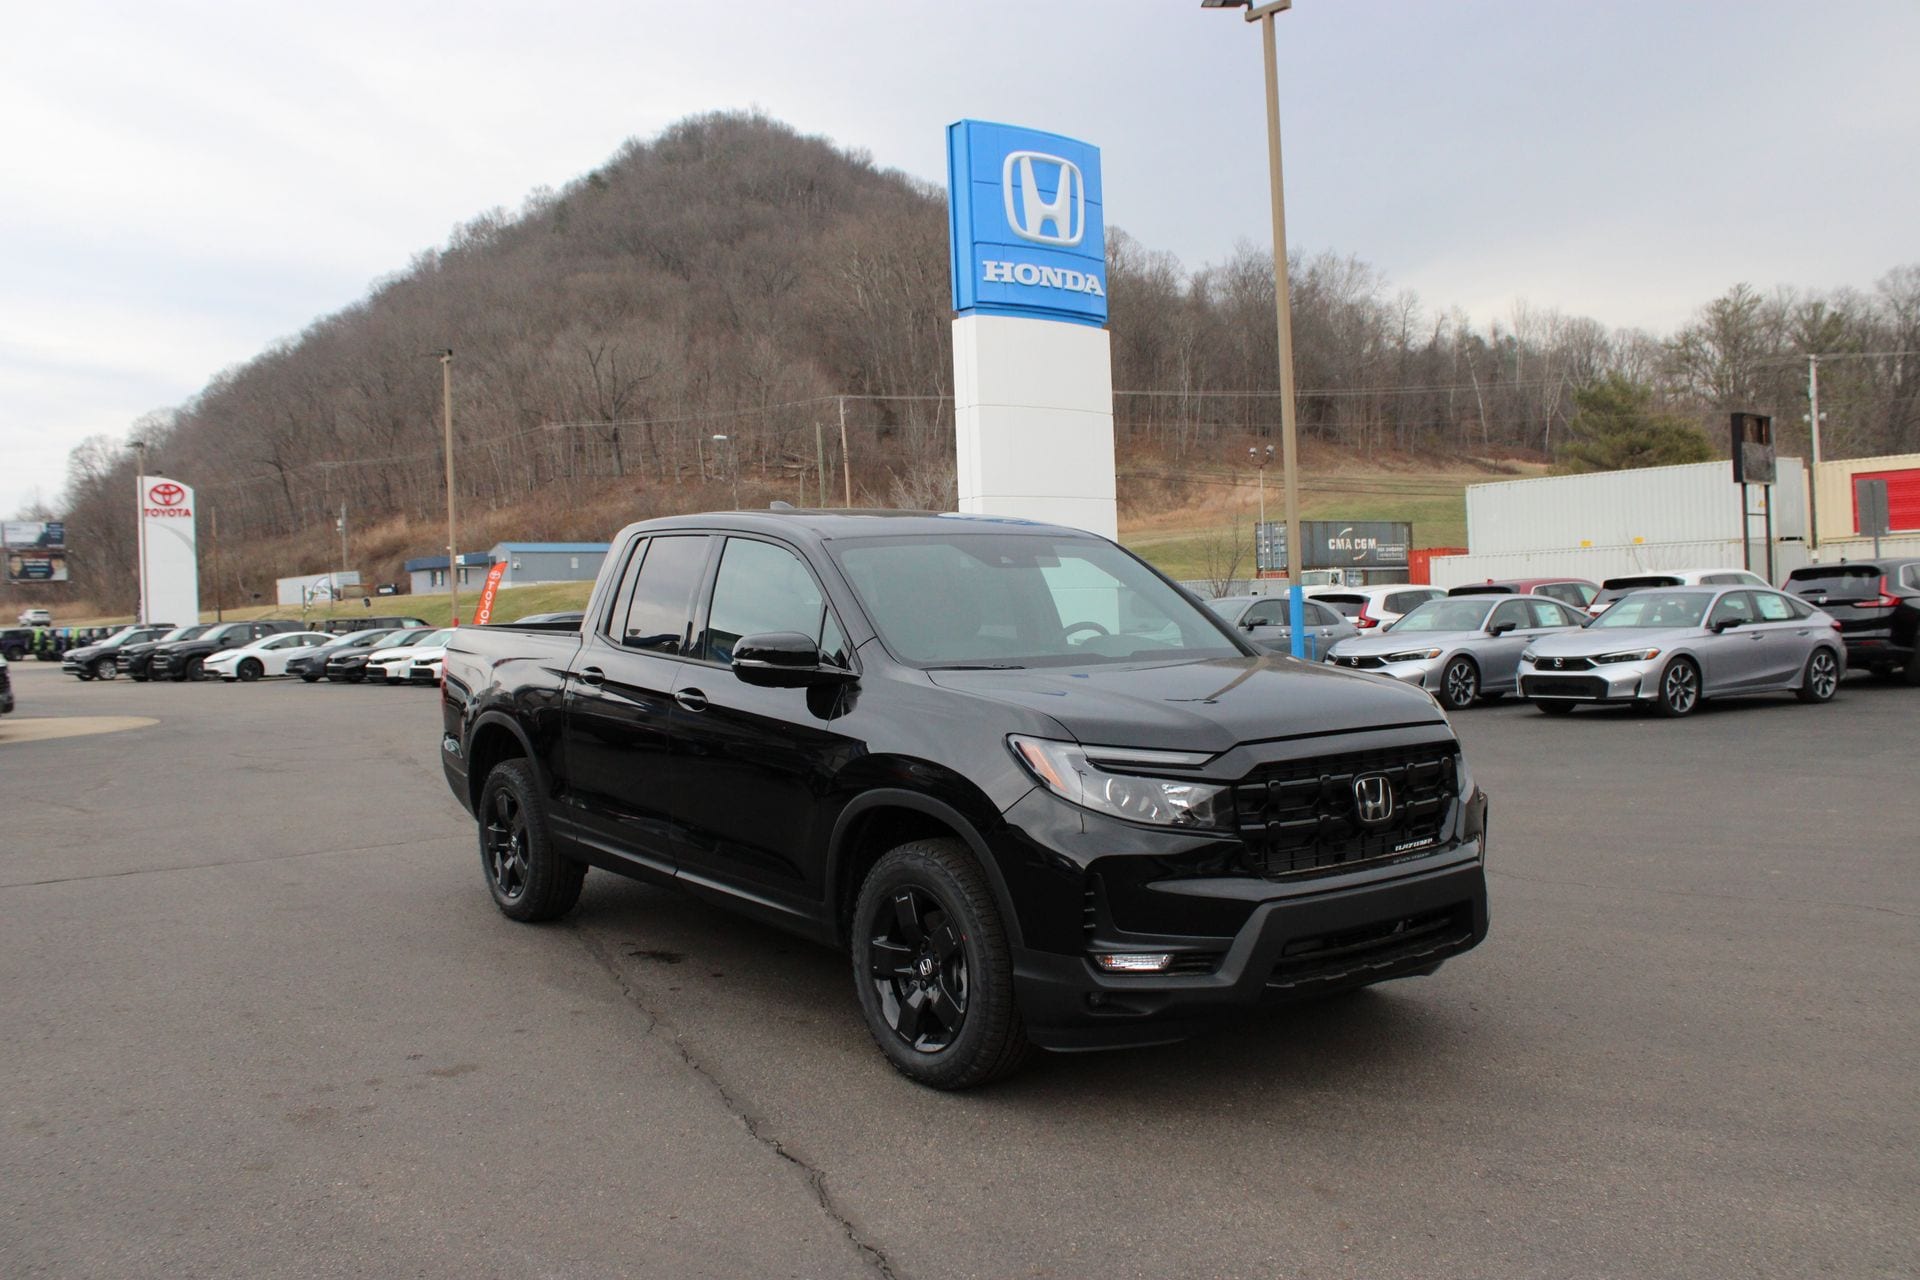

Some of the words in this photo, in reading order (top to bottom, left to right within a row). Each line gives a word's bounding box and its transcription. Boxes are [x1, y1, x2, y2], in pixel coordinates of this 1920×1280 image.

[983, 260, 1105, 297] HONDA
[144, 508, 192, 517] TOYOTA
[1328, 538, 1352, 550] CMA
[1354, 538, 1377, 549] CGM
